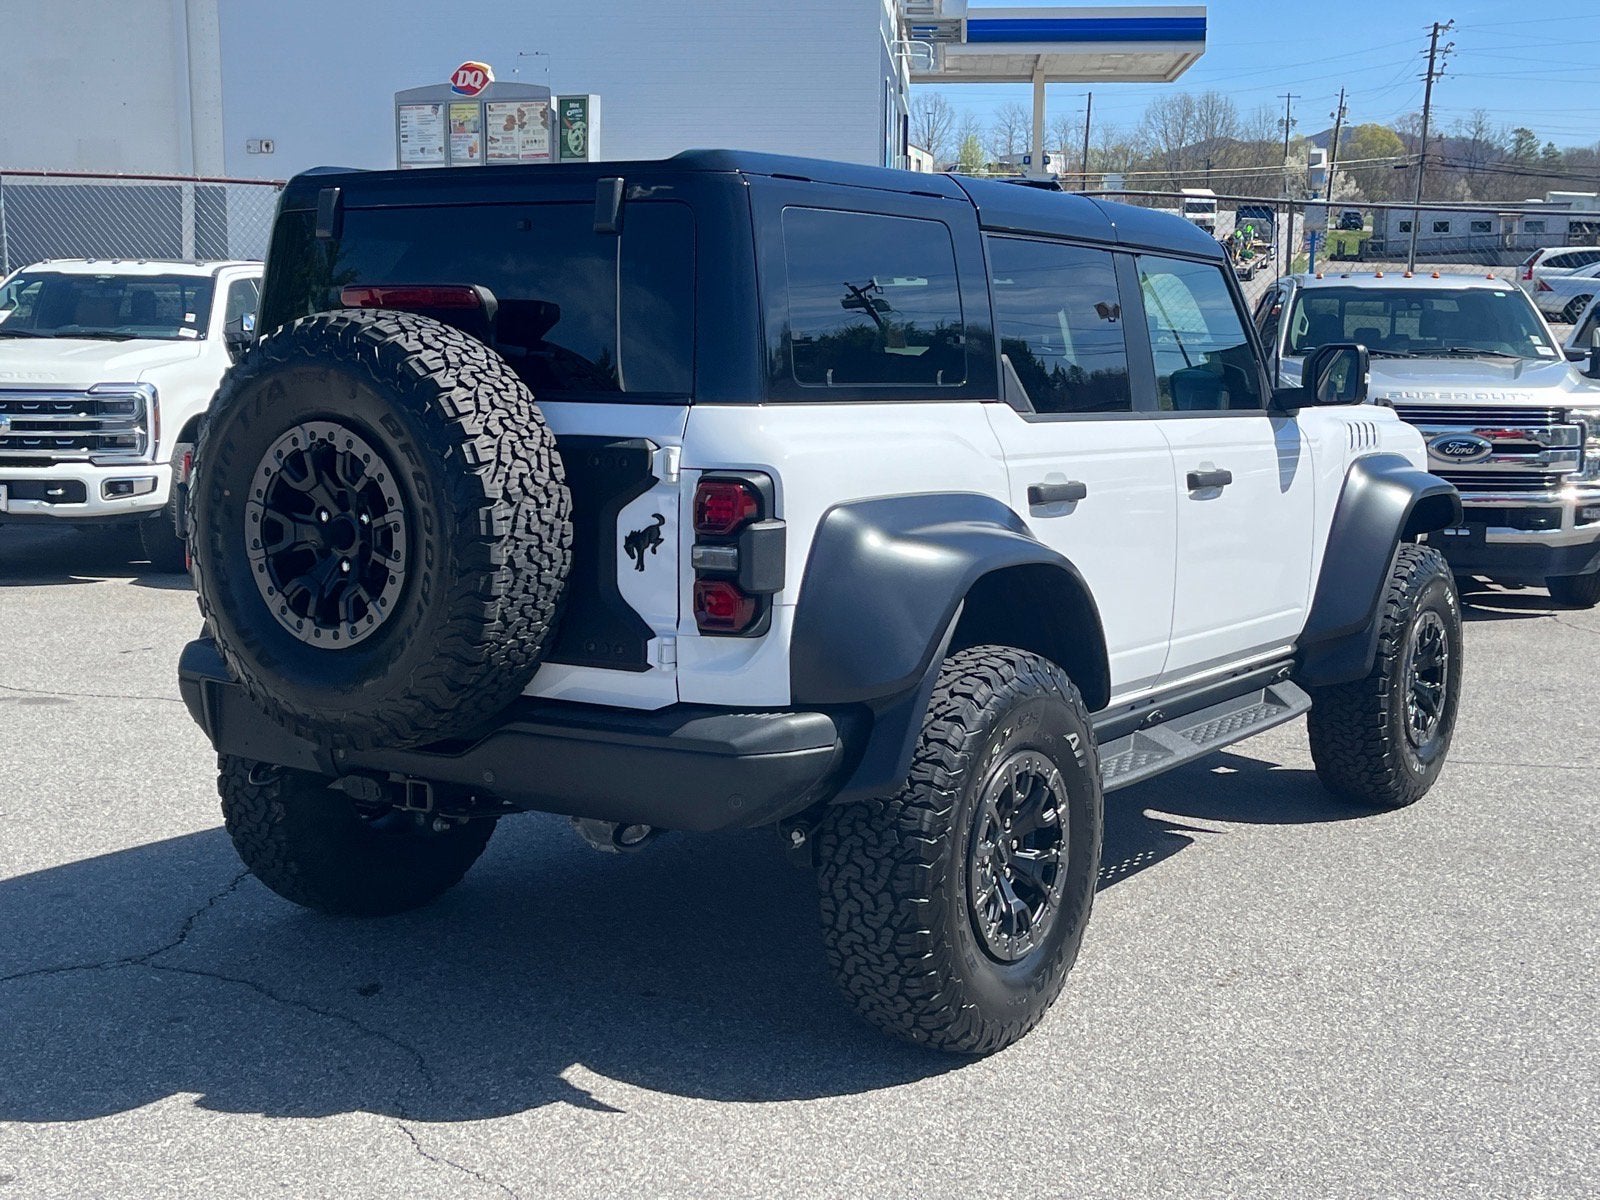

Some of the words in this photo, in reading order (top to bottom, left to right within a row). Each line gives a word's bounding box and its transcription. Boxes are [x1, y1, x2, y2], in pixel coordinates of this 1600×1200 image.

[456, 69, 485, 90] DQ
[1384, 391, 1468, 400] SUPER
[1473, 392, 1534, 401] DUTY
[1445, 441, 1476, 455] Ford
